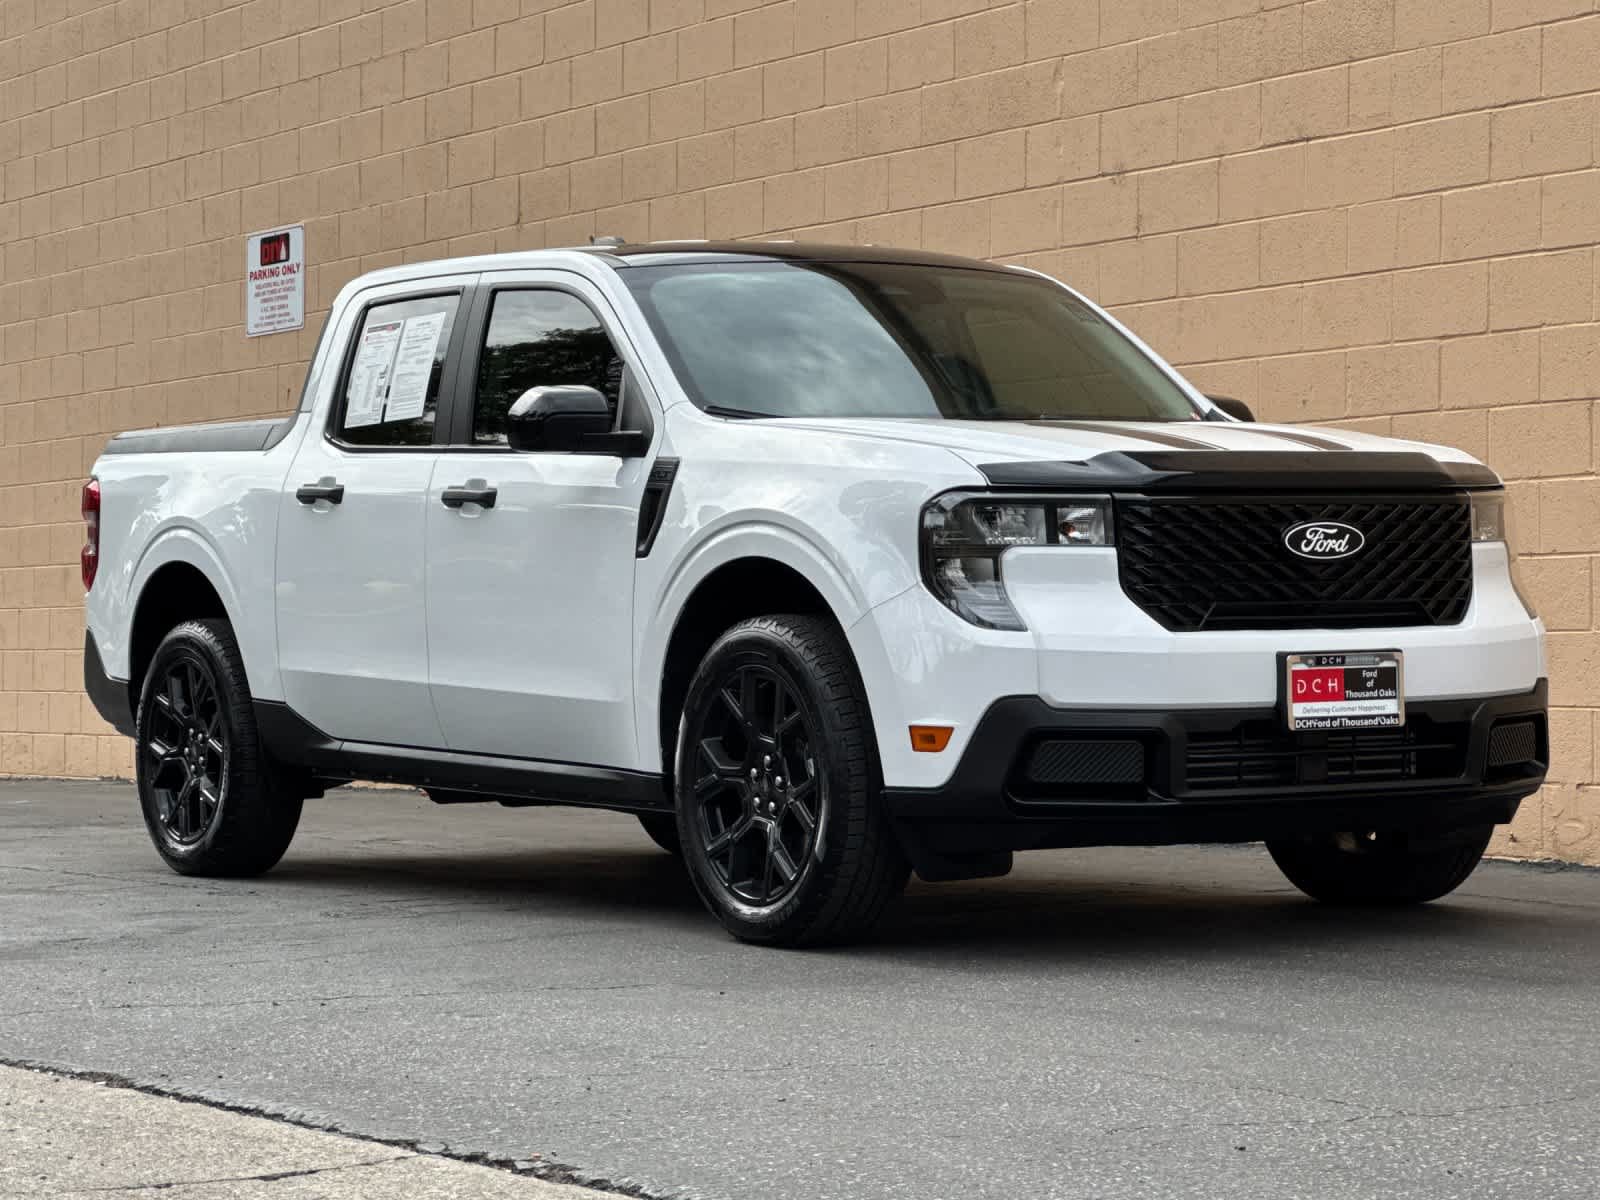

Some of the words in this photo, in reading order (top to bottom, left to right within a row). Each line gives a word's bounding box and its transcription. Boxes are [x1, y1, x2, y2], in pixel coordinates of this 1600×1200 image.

[249, 267, 280, 281] PARKING
[281, 262, 301, 276] ONLY
[1301, 527, 1350, 552] Ford
[1321, 656, 1343, 665] DCH
[1362, 669, 1378, 678] Ford
[1297, 678, 1339, 694] DCH
[1366, 680, 1374, 688] of
[1345, 689, 1378, 698] Thousand
[1379, 688, 1396, 697] Oaks
[1332, 718, 1341, 727] of
[1342, 716, 1379, 727] Thousand
[1379, 714, 1400, 725] Oaks
